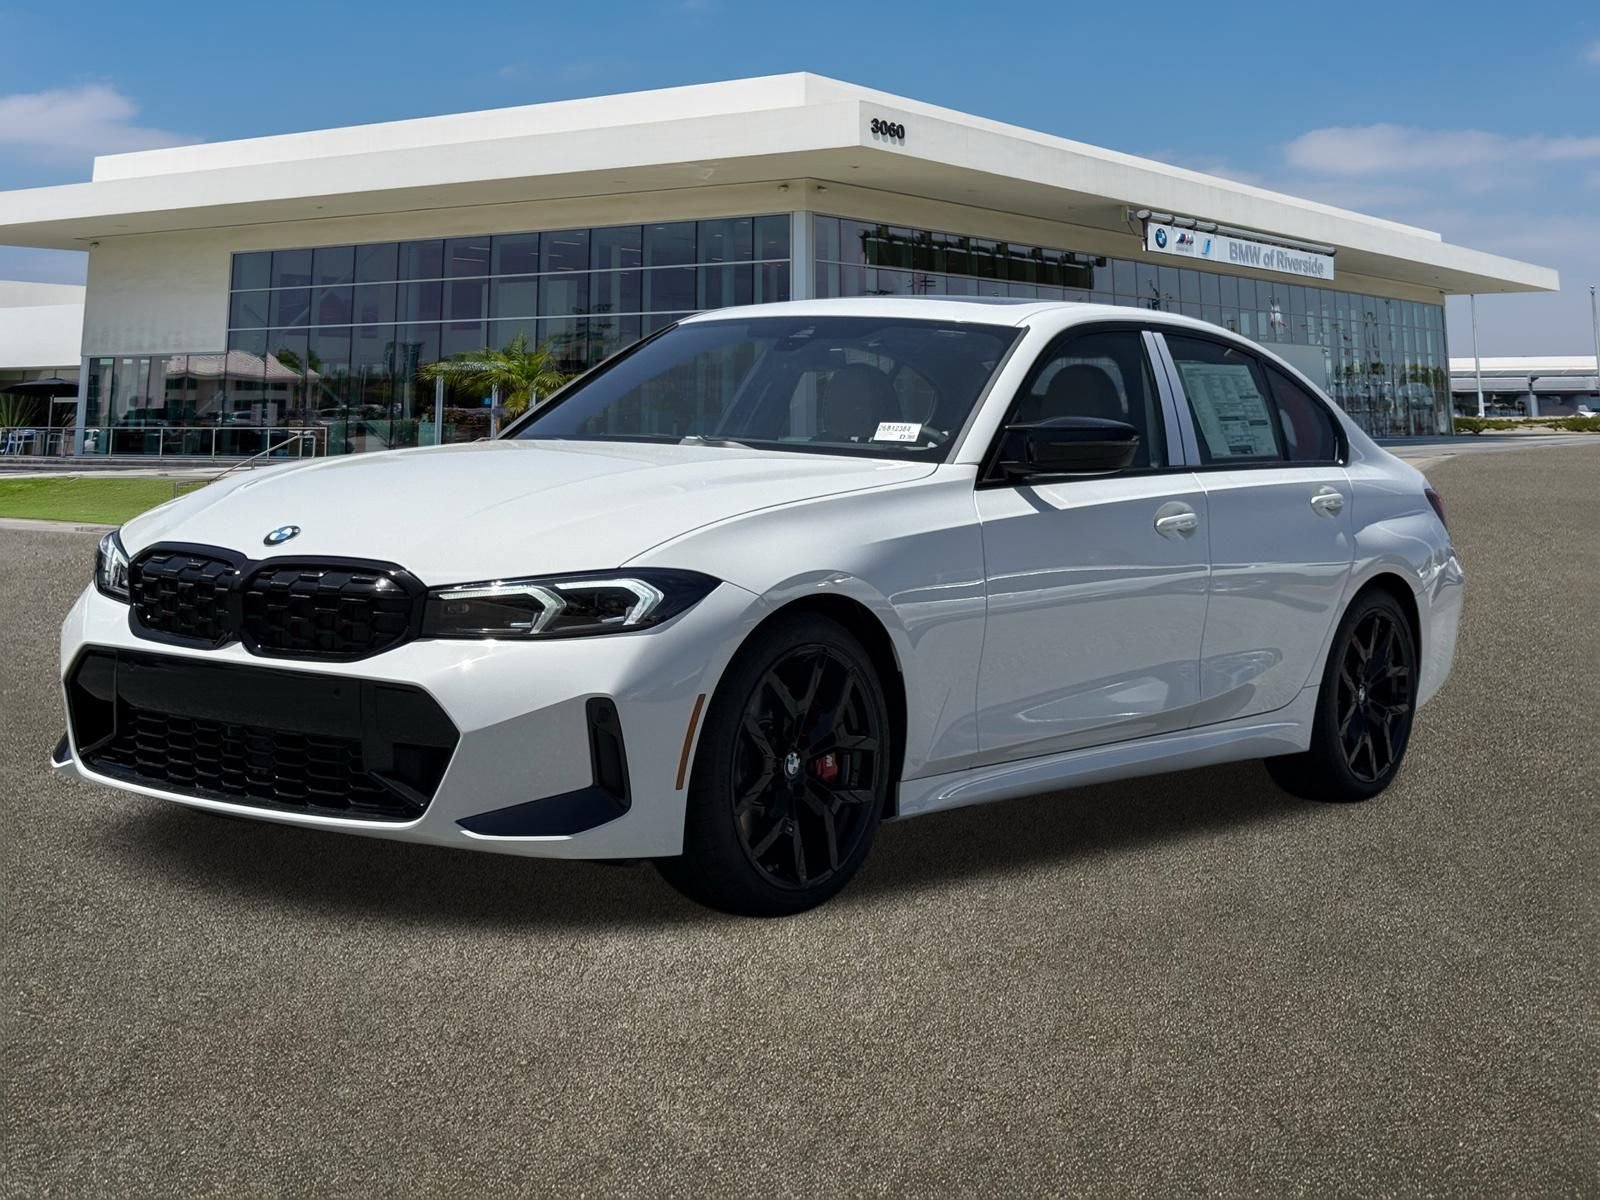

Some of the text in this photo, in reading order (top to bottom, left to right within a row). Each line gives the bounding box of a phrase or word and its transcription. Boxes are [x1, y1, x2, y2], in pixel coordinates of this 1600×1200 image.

[871, 118, 905, 139] 3060
[1229, 241, 1324, 275] BMW of Riverside
